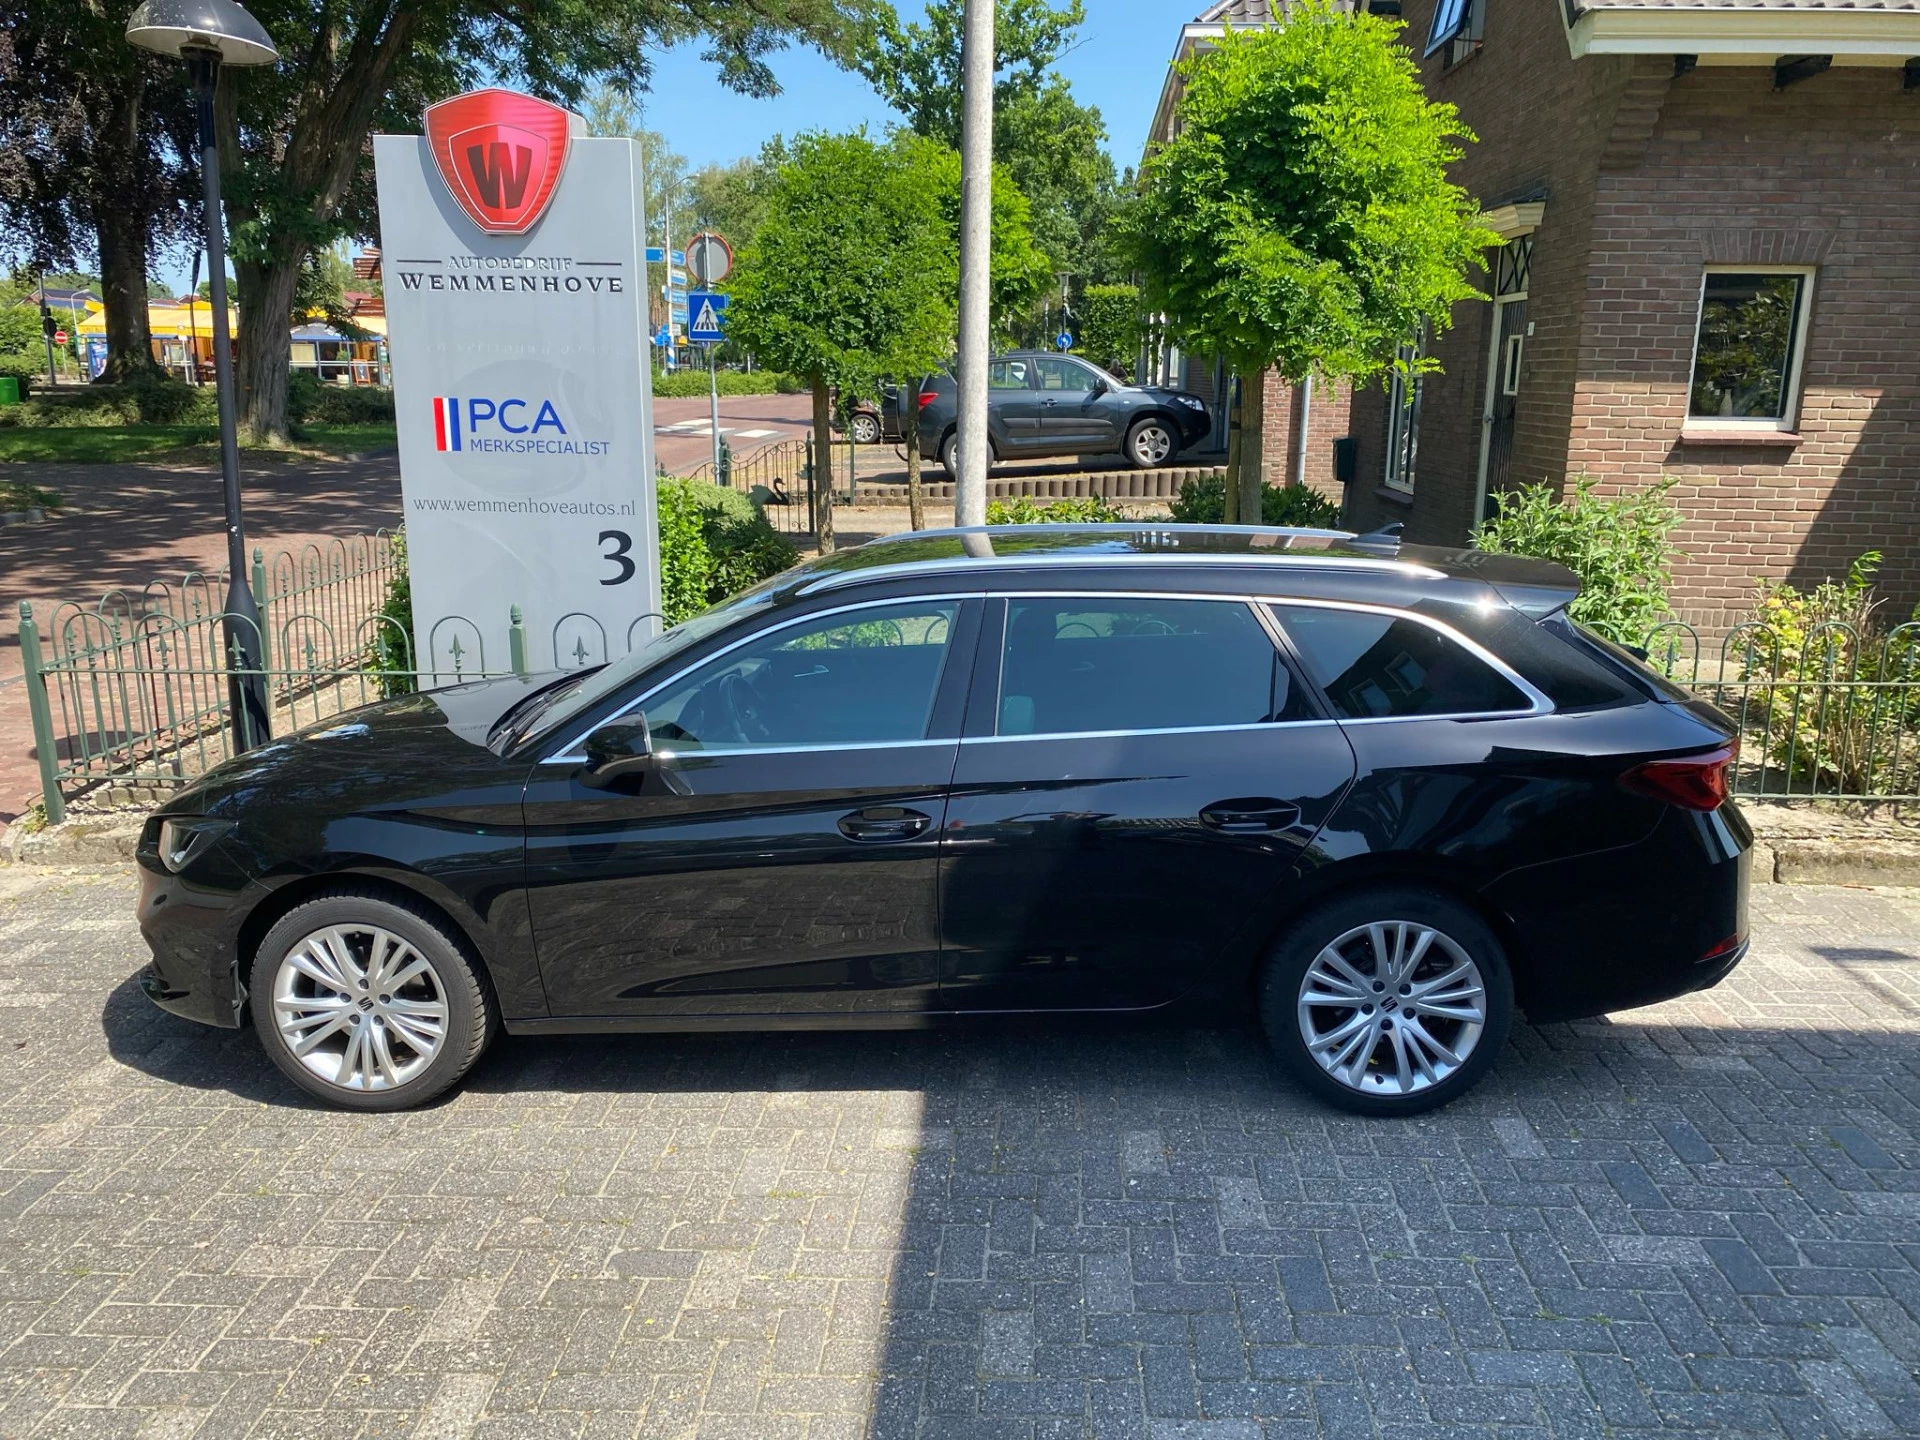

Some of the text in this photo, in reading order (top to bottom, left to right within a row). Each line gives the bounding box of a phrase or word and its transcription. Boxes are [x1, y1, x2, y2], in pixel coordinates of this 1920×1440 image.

[466, 141, 532, 210] W
[447, 256, 572, 272] AUTOBEDRIJF
[398, 272, 623, 293] WEMMENHOVE
[469, 398, 567, 435] PCA
[470, 438, 611, 456] MERKSPECIALIST
[413, 497, 636, 516] www.wemmenhoveautos.nl
[597, 529, 636, 586] 3
